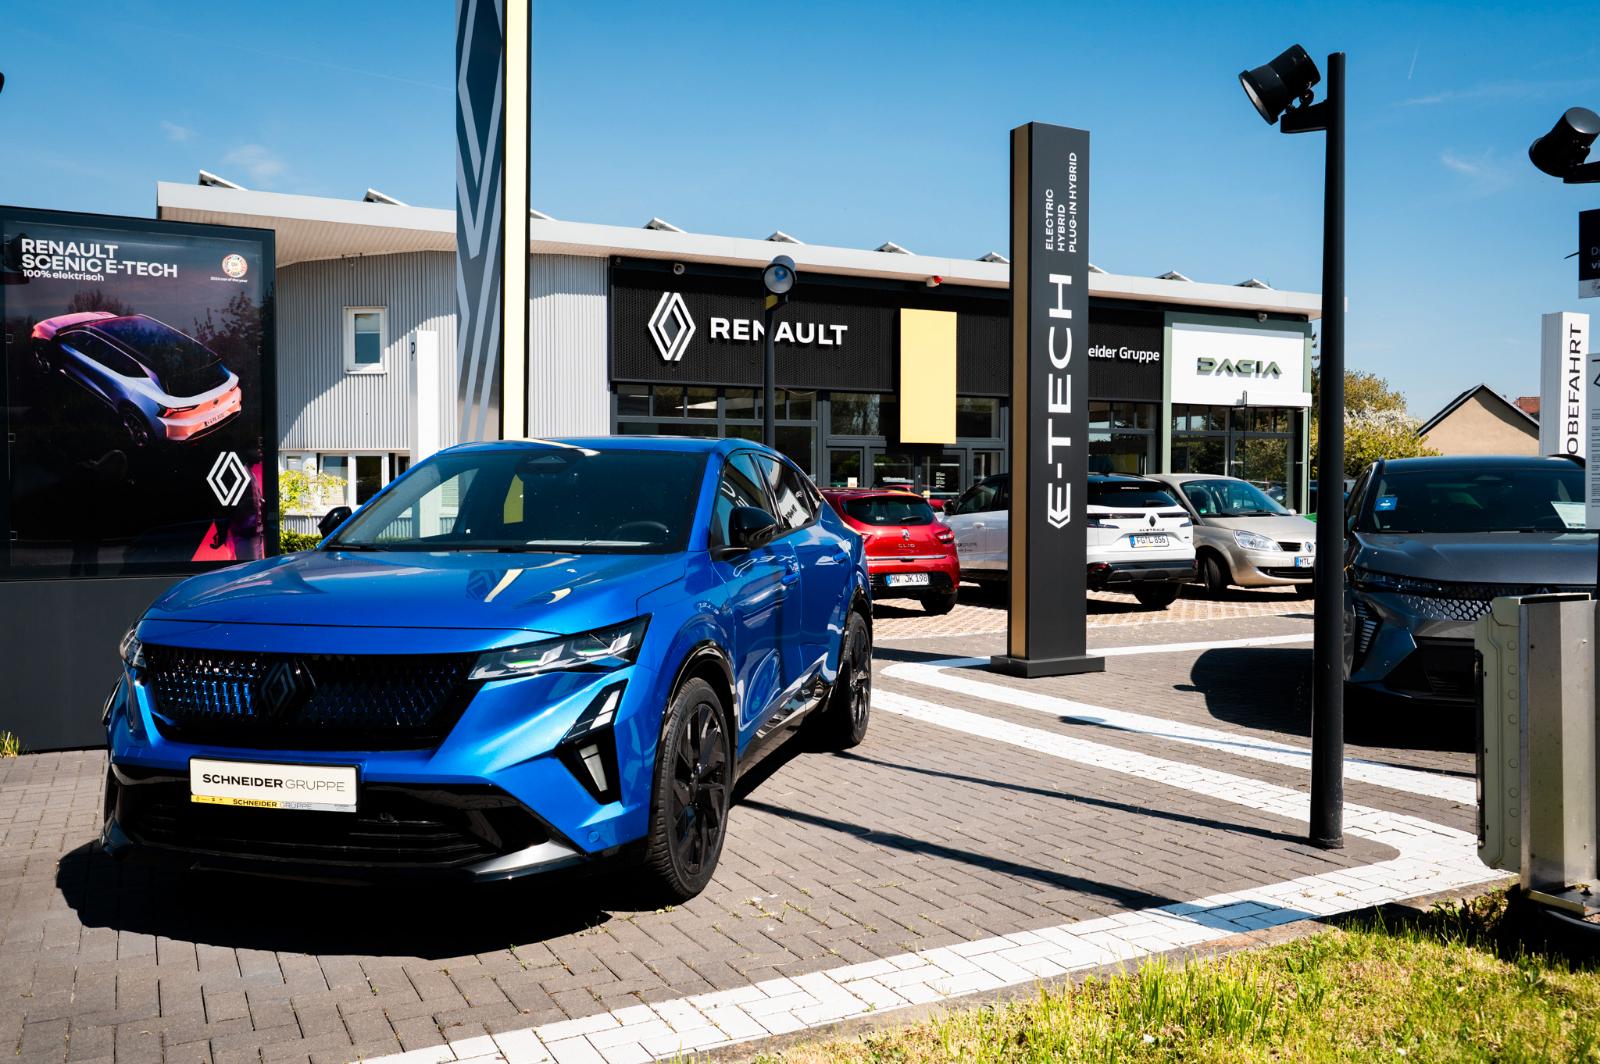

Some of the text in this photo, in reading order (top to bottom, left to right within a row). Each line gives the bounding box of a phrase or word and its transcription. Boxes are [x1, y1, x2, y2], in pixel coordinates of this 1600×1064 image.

[1069, 152, 1077, 253] PLUG-IN HYBRID
[1045, 188, 1054, 250] ELECTRIC
[1057, 203, 1065, 252] HYBRID
[21, 238, 119, 259] RENAULT
[22, 254, 178, 278] SCENIC E-TECH
[23, 269, 105, 282] 100% elektrisch
[1088, 344, 1160, 364] eider Gruppe
[1197, 357, 1282, 378] DACIA
[1566, 323, 1582, 455] OBEFAHRT
[1047, 273, 1073, 529] E-TECH
[202, 773, 346, 792] SCHNEIDER GRUPPE
[233, 798, 278, 808] SCHNEIDER
